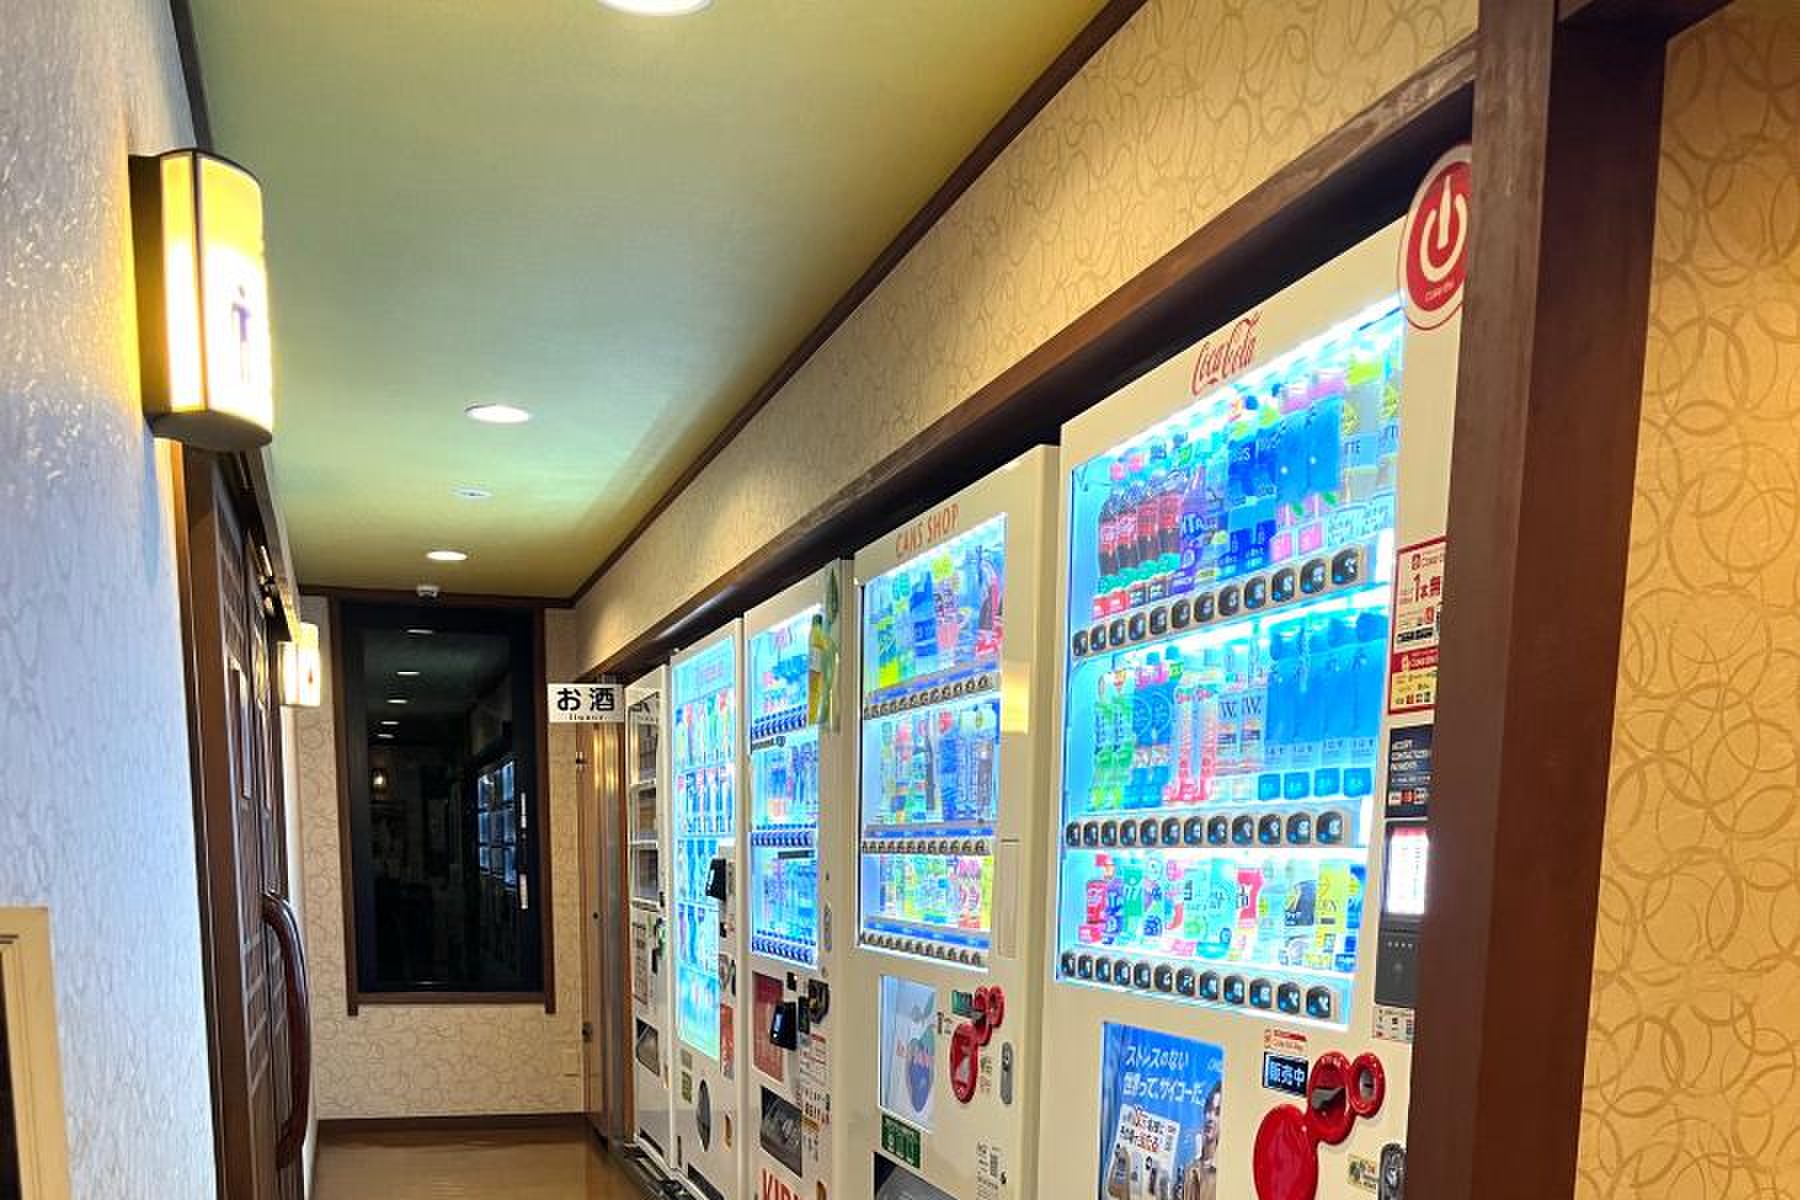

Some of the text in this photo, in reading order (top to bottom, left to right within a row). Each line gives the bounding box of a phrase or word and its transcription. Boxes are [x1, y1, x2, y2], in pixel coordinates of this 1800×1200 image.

[896, 502, 960, 558] CANS SHOP
[556, 687, 615, 712] お酒
[1269, 1060, 1306, 1087] 販売中
